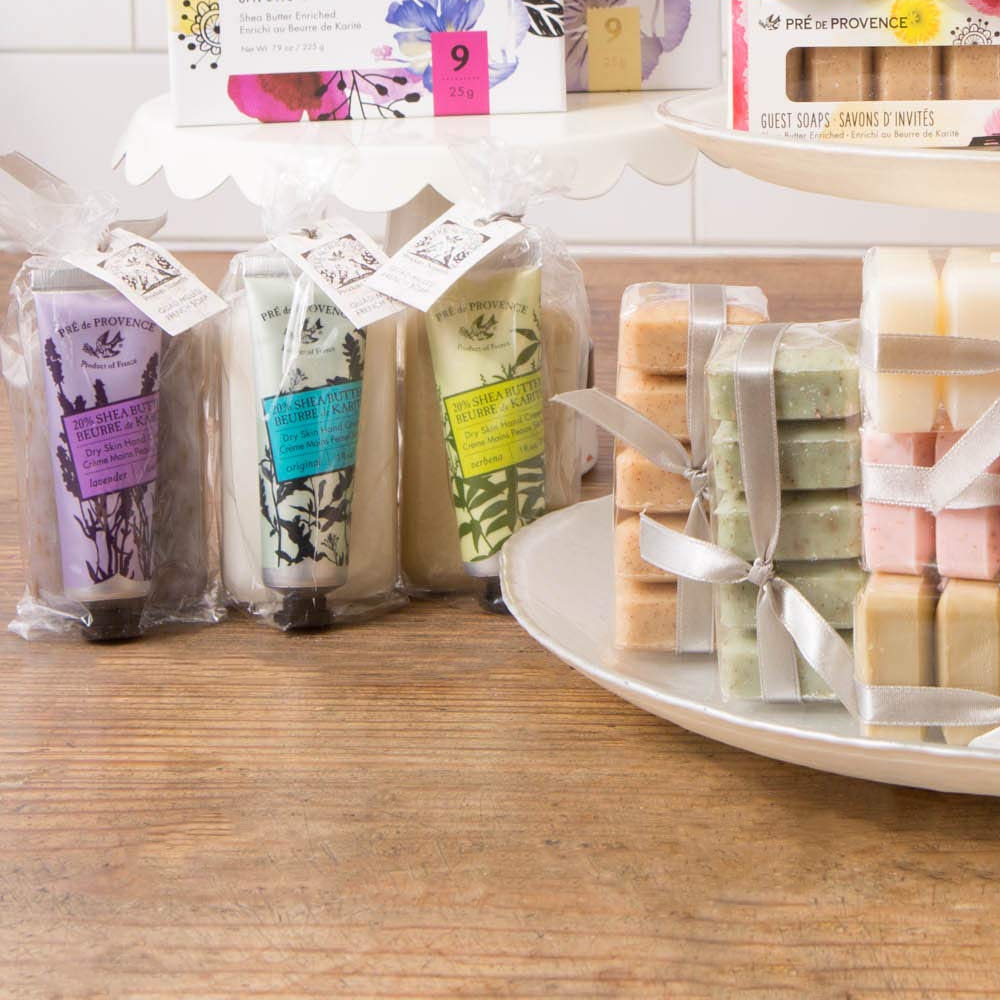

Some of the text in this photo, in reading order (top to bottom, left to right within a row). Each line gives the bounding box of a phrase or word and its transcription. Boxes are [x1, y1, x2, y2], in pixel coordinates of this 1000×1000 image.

[240, 9, 336, 22] Shea Butter Enriched
[786, 15, 908, 29] PRÉ DE PROVENCE
[240, 26, 270, 34] Enrichi
[289, 24, 317, 33] Beurre
[321, 23, 332, 32] de
[605, 17, 622, 42] 9
[451, 45, 469, 71] 9
[761, 113, 792, 128] GUEST
[797, 112, 830, 128] SOAPS
[839, 111, 879, 127] SAVONS
[261, 305, 281, 321] PRÉ
[58, 316, 156, 337] PRÉ de PROVENCE
[295, 396, 325, 410] SHEA
[472, 391, 503, 407] SHEA
[96, 408, 128, 424] SHEA
[274, 408, 318, 425] BEURRE
[456, 404, 497, 424] BEURRE
[76, 421, 122, 442] BEURRE
[85, 440, 122, 458] Dry Skin
[90, 472, 127, 488] lavender
